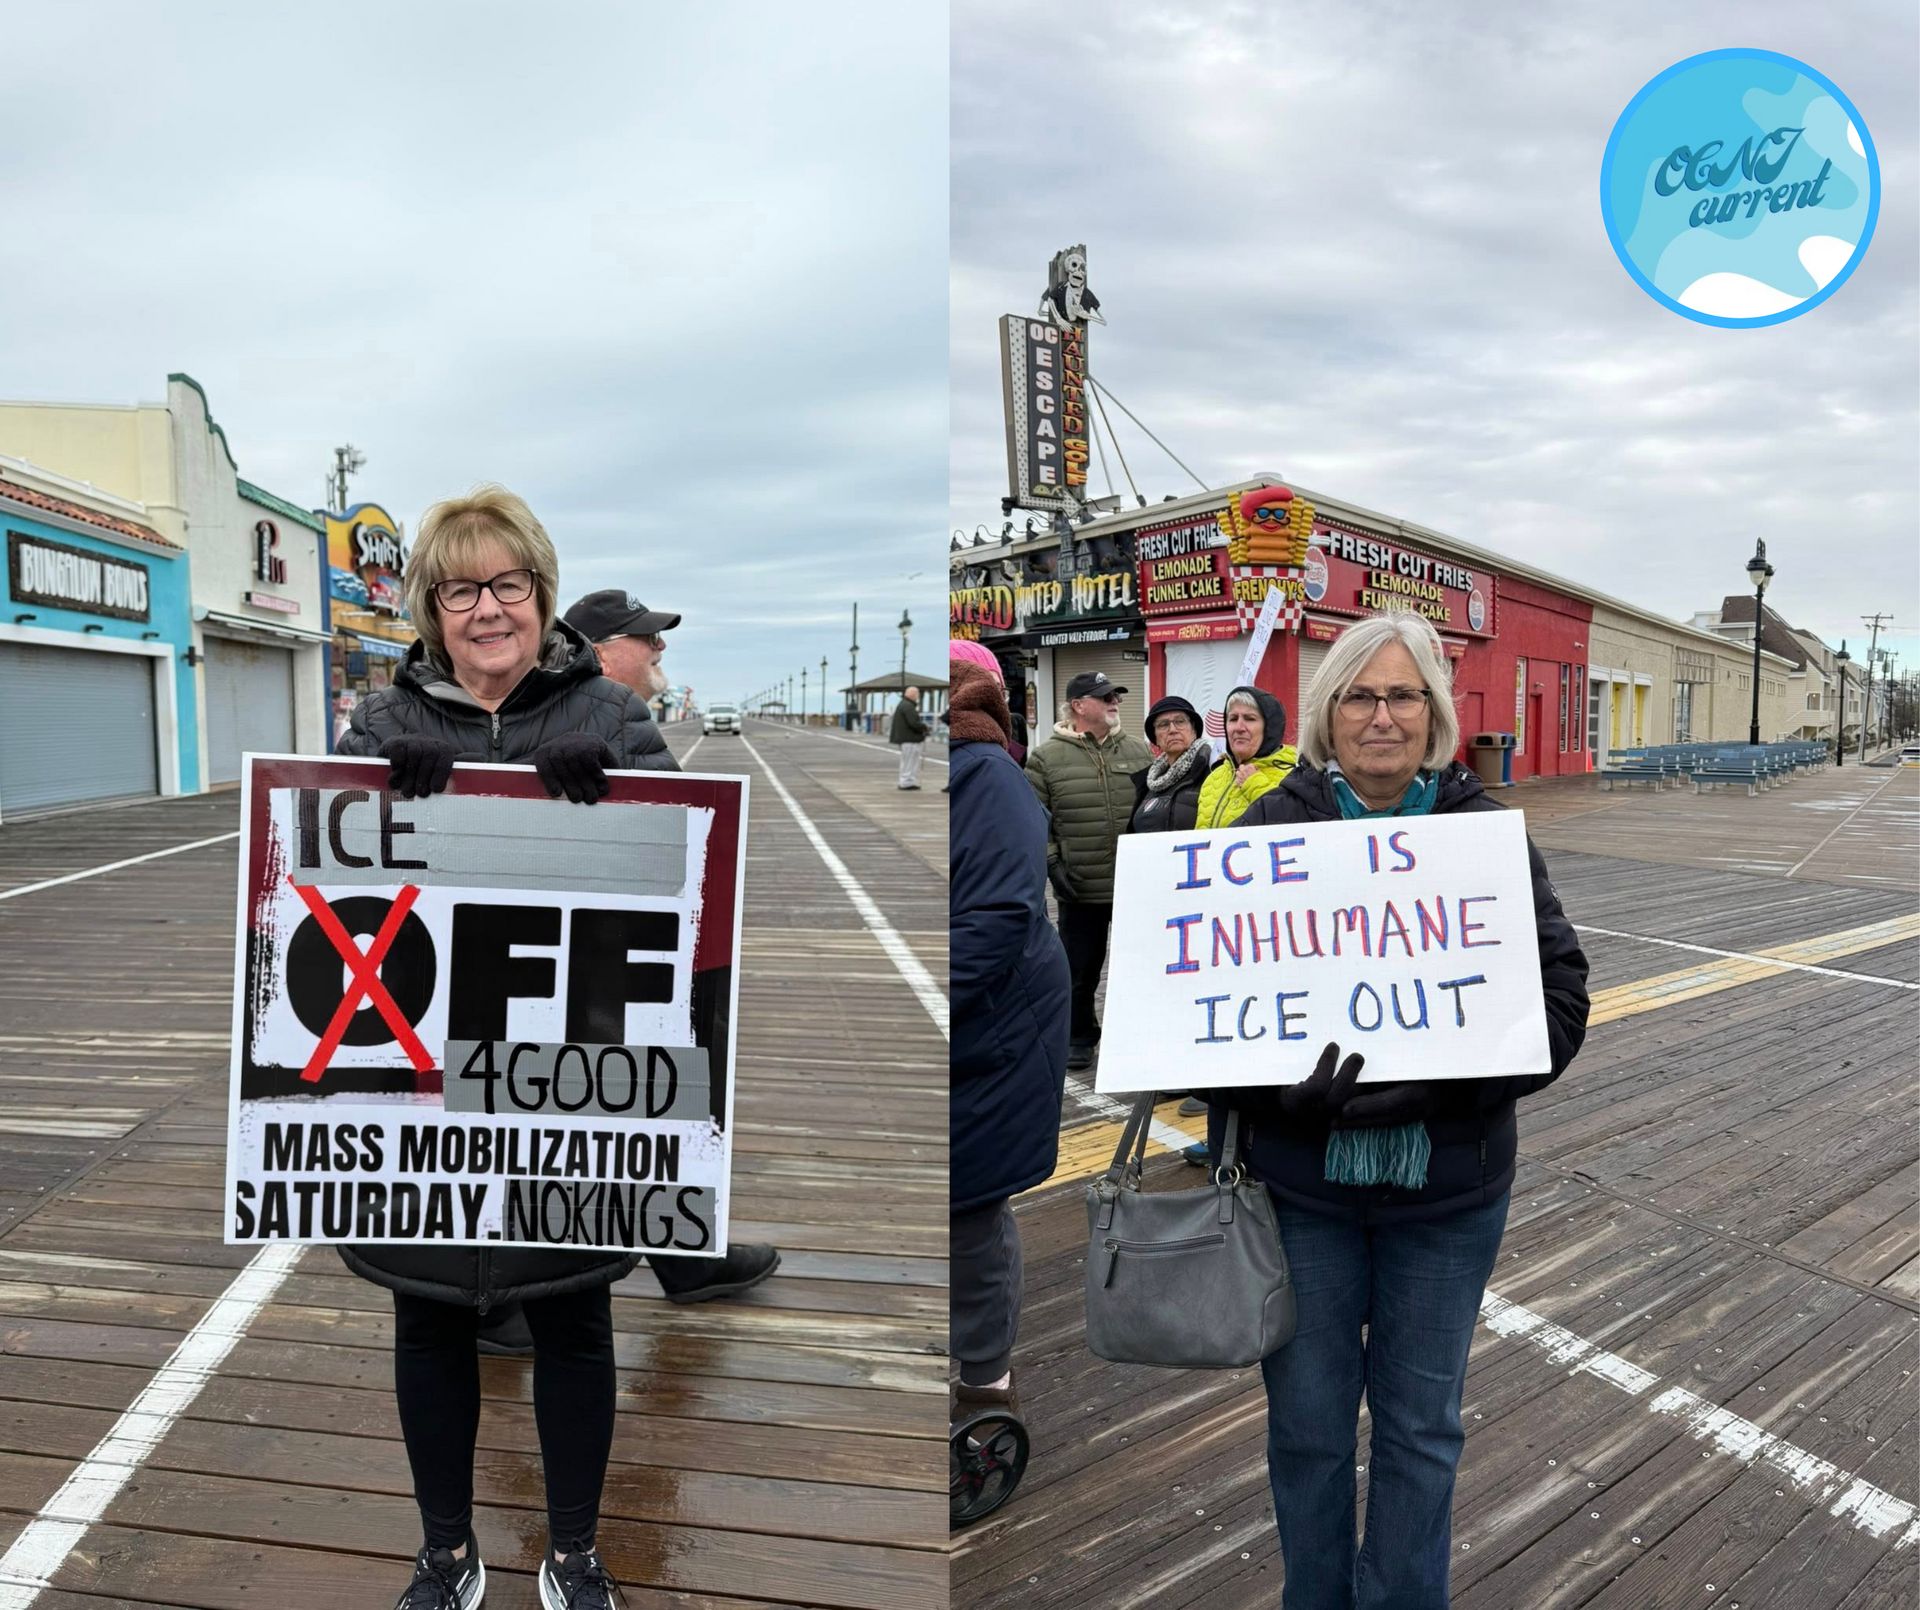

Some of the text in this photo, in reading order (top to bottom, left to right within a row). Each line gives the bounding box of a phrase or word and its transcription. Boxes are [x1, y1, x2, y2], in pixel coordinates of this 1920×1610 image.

[1030, 323, 1058, 345] OC
[1062, 327, 1085, 434] HAUNTED
[1036, 346, 1056, 484] ESCAPE
[1063, 438, 1088, 487] GOLF
[1140, 532, 1169, 560] FRESH
[1171, 528, 1191, 555] CUT
[1152, 555, 1212, 580] LEMONADE
[1329, 530, 1473, 591] FRESH CUT FRIES
[19, 543, 148, 612] BUNGALOW BOWLS
[1072, 572, 1136, 614] HOTEL
[1147, 576, 1221, 604] FUNNEL CAKE
[1371, 571, 1444, 602] LEMONADE
[1420, 603, 1452, 621] CAKE
[297, 789, 428, 870] ICE
[1173, 831, 1416, 890] ICE IS
[1165, 896, 1501, 974] INHUMANE
[285, 895, 680, 1047] OFF
[1195, 975, 1487, 1044] ICE OUT
[263, 1123, 680, 1183] MASS MOBILIZATION
